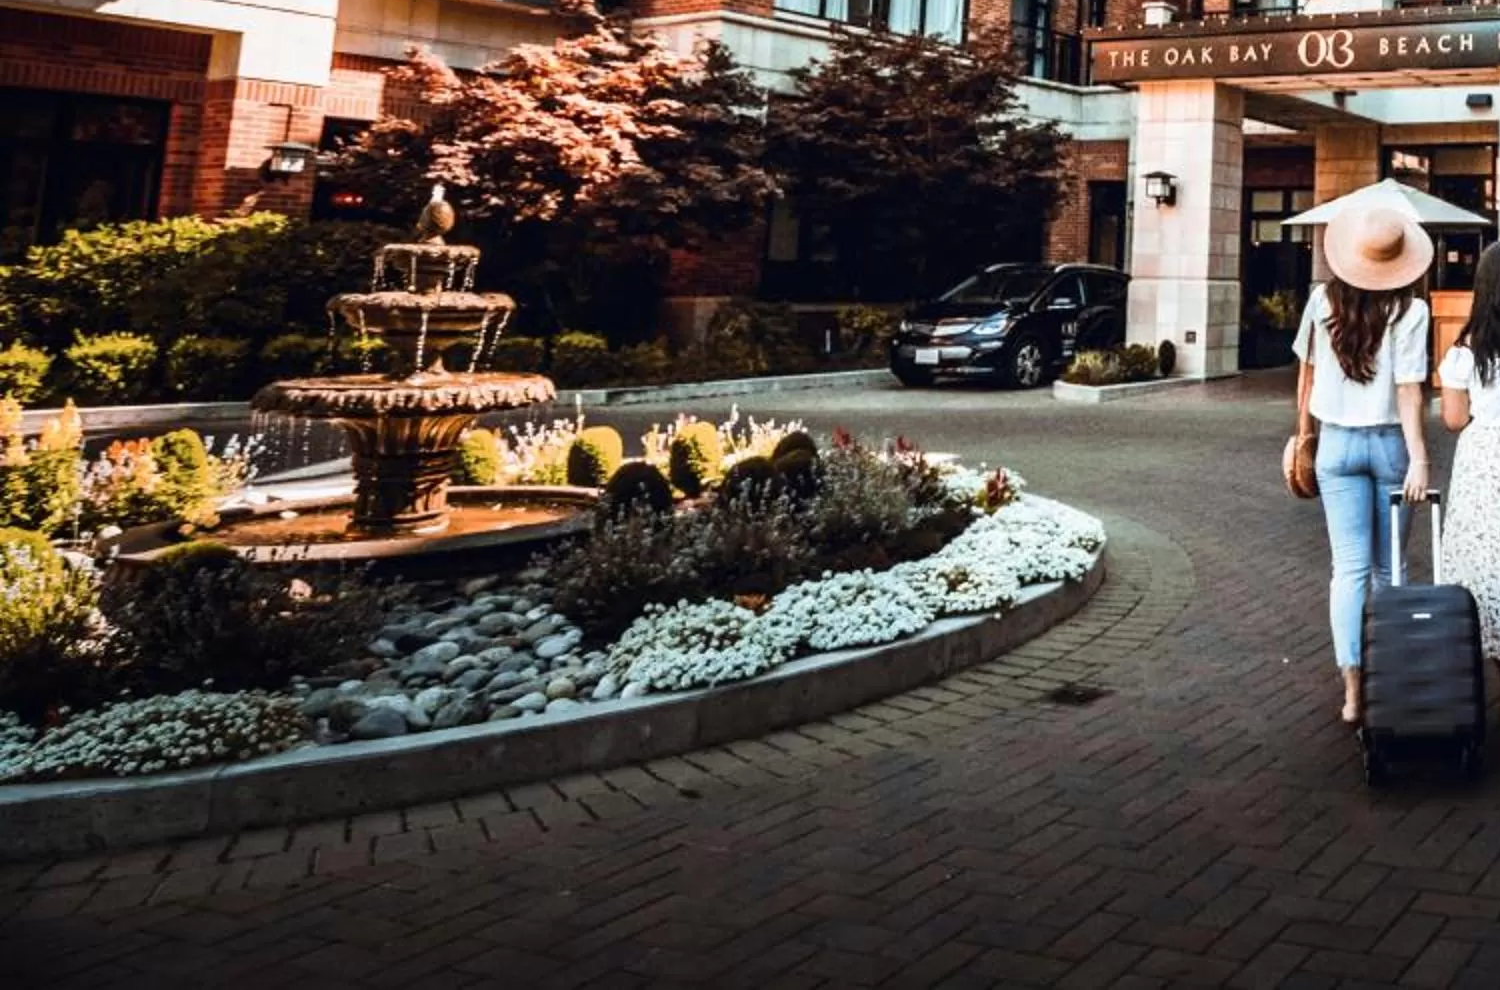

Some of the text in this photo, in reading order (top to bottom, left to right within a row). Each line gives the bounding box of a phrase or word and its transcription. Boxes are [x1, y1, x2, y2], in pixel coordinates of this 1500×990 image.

[1108, 49, 1150, 67] THE
[1164, 47, 1213, 65] OAK
[1229, 42, 1273, 62] BAY
[1379, 33, 1474, 55] BEACH
